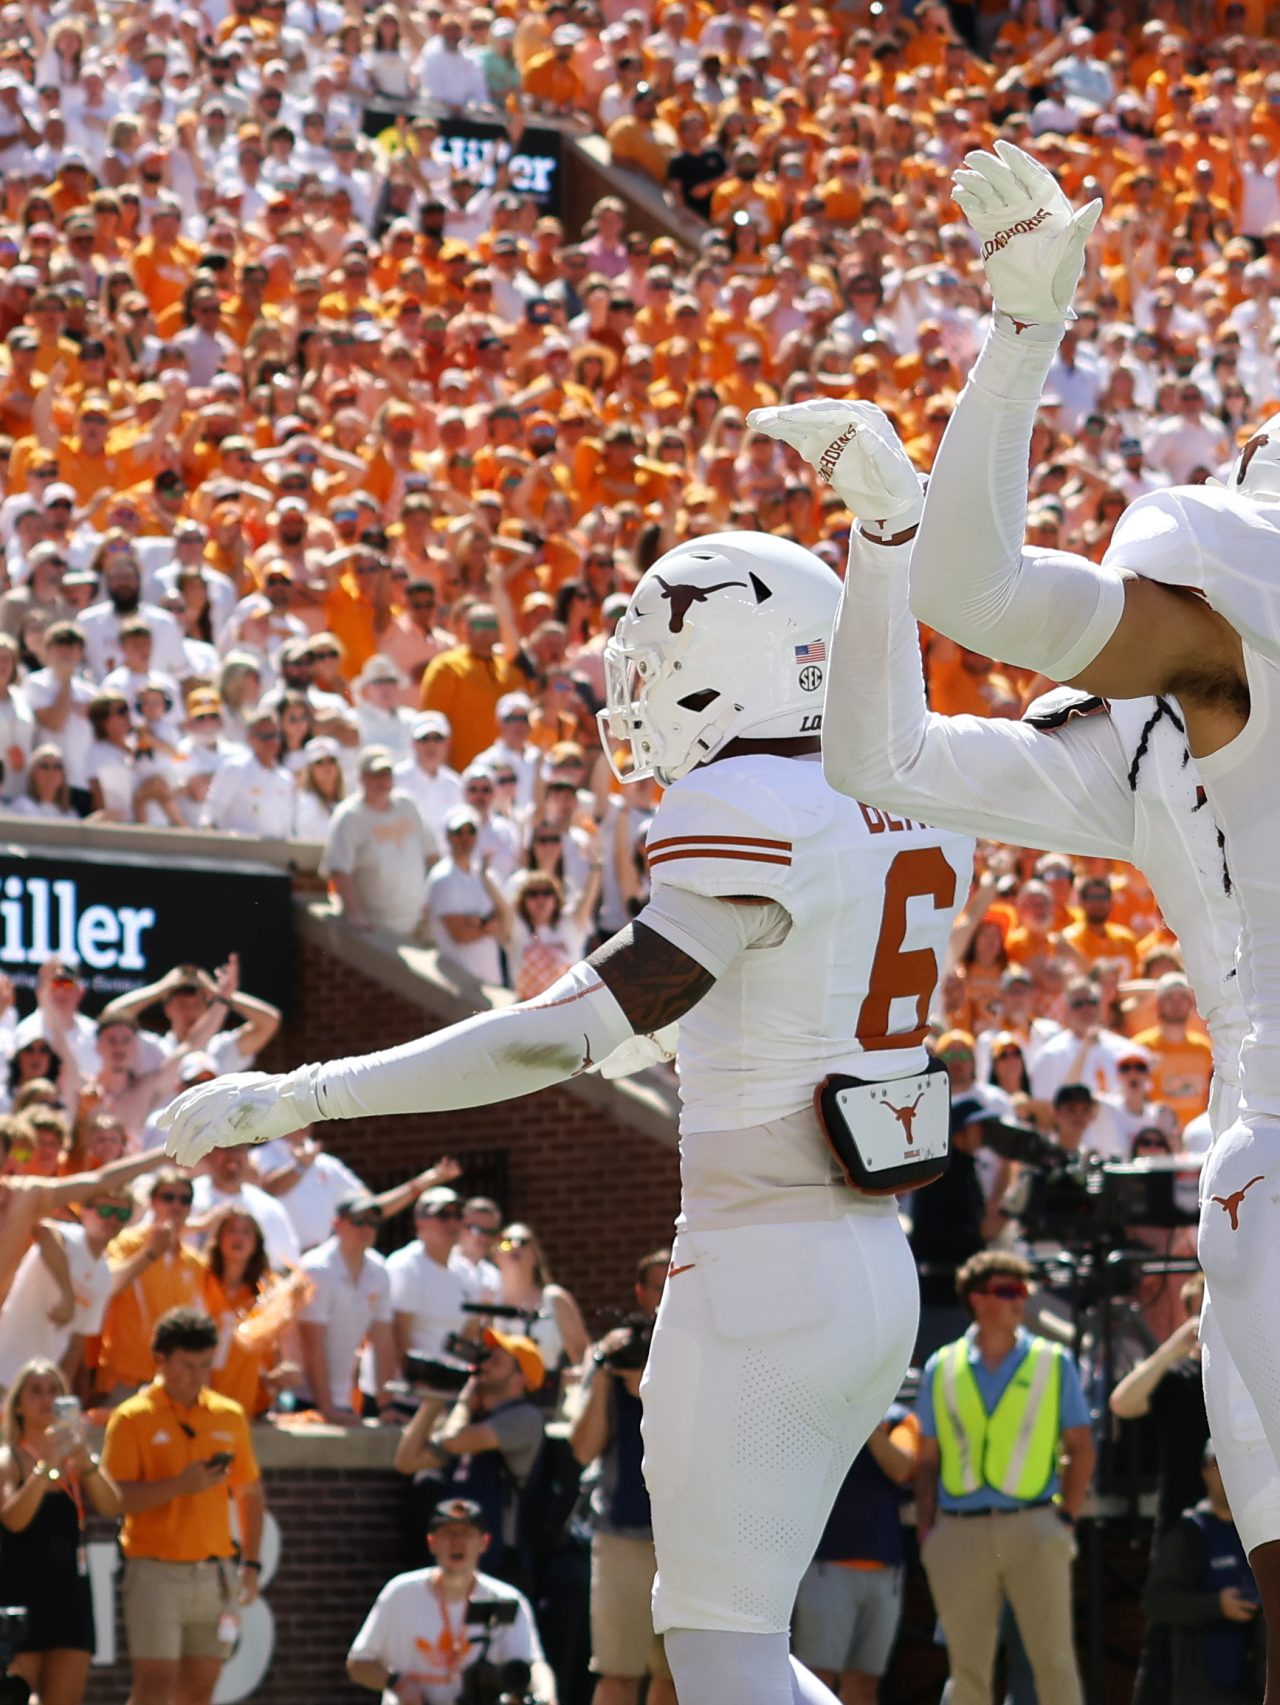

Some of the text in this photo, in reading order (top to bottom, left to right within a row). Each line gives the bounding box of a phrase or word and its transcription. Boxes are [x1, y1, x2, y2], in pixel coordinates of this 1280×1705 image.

[798, 666, 822, 691] SEC
[0, 875, 156, 970] iller
[854, 846, 957, 1052] 6
